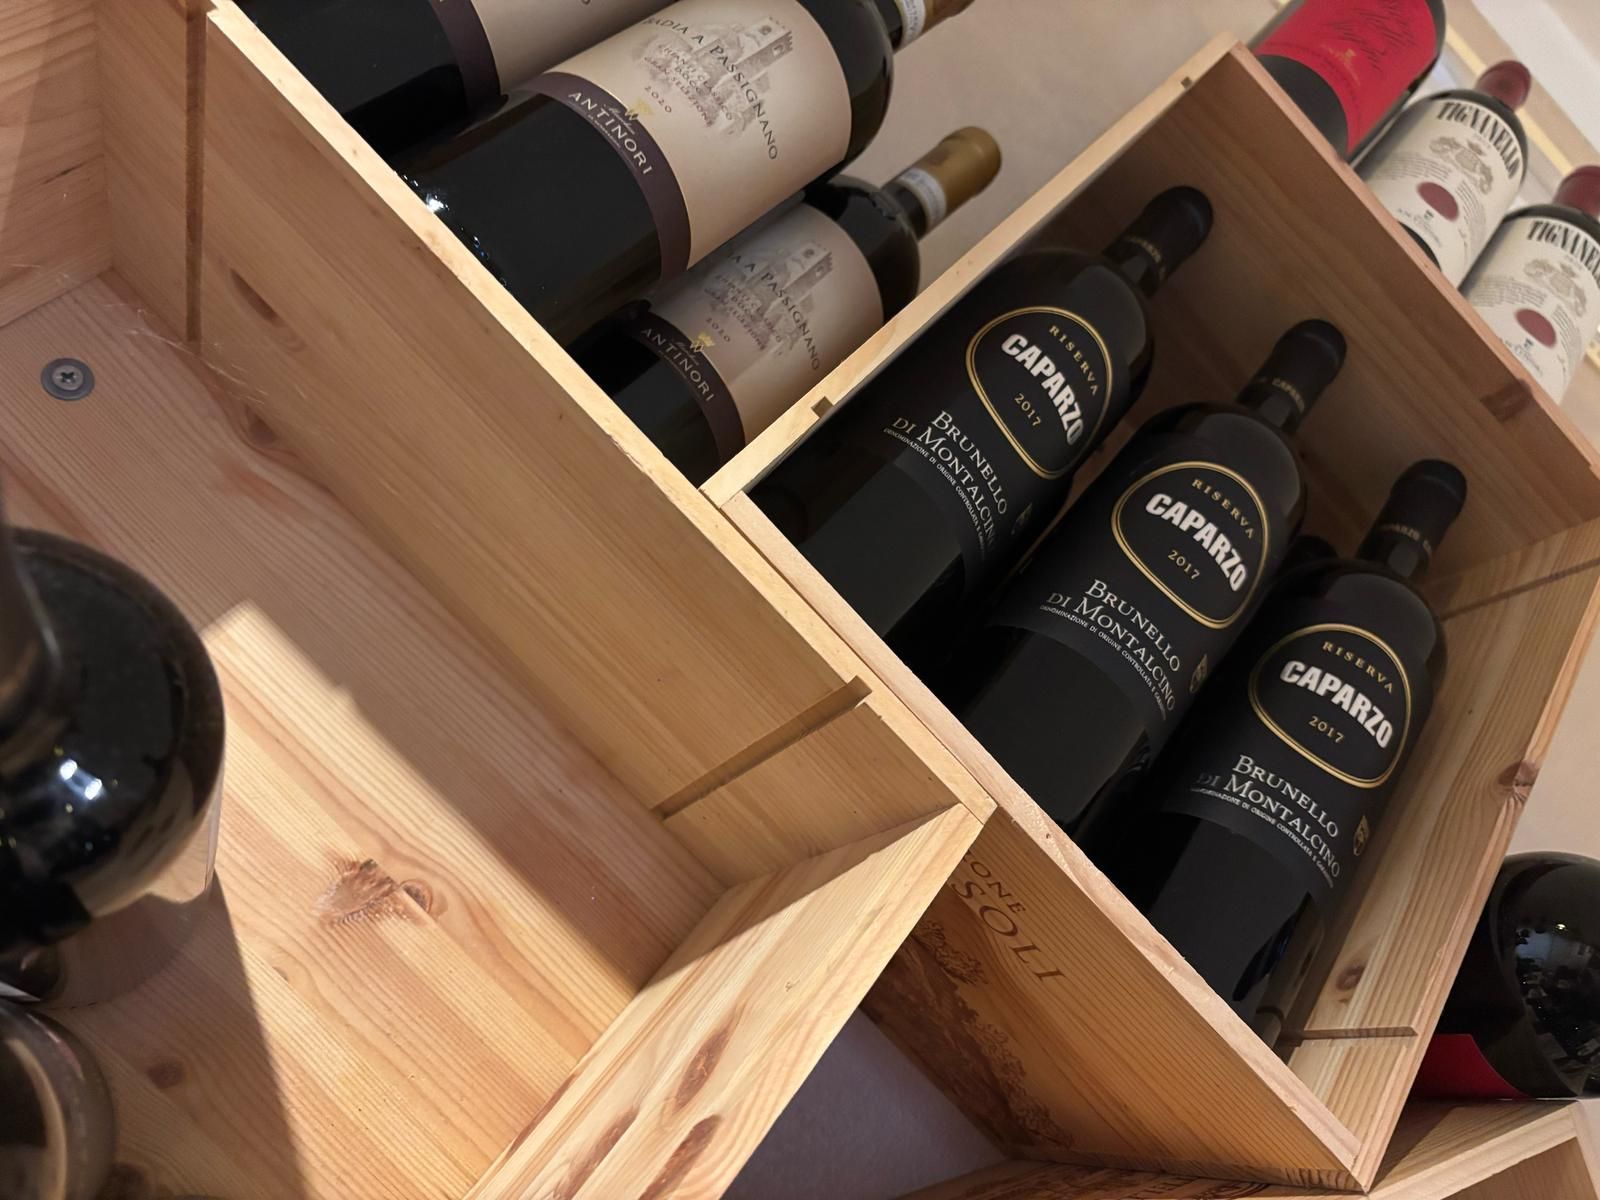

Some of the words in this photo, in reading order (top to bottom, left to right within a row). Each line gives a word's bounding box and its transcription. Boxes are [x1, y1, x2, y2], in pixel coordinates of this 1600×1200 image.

[568, 92, 653, 175] ANTINORI
[644, 86, 672, 113] 2020
[692, 35, 705, 45] A
[710, 45, 778, 160] PASSIGNANO
[1436, 101, 1521, 180] TIGNANELLO
[761, 272, 820, 369] PASSIGNANO
[1049, 324, 1100, 396] RISERVA
[641, 328, 715, 401] ANTINORI
[1000, 332, 1085, 447] CAPARZO
[892, 417, 917, 435] DI
[1014, 393, 1043, 428] 2017
[931, 410, 1007, 515] BRUNELLO
[1145, 492, 1250, 593] CAPARZO
[1192, 478, 1255, 540] RISERVA
[1167, 550, 1201, 581] 2017
[1047, 592, 1072, 608] DI
[1073, 596, 1176, 711] MONTALCINO
[1085, 579, 1180, 672] BRUNELLO
[1279, 660, 1394, 750] CAPARZO
[1321, 640, 1394, 695] RISERVA
[1308, 715, 1345, 744] 2017
[1224, 774, 1340, 878] MONTALCINO
[1232, 754, 1339, 838] BRUNELLO
[949, 880, 1068, 982] SOLI
